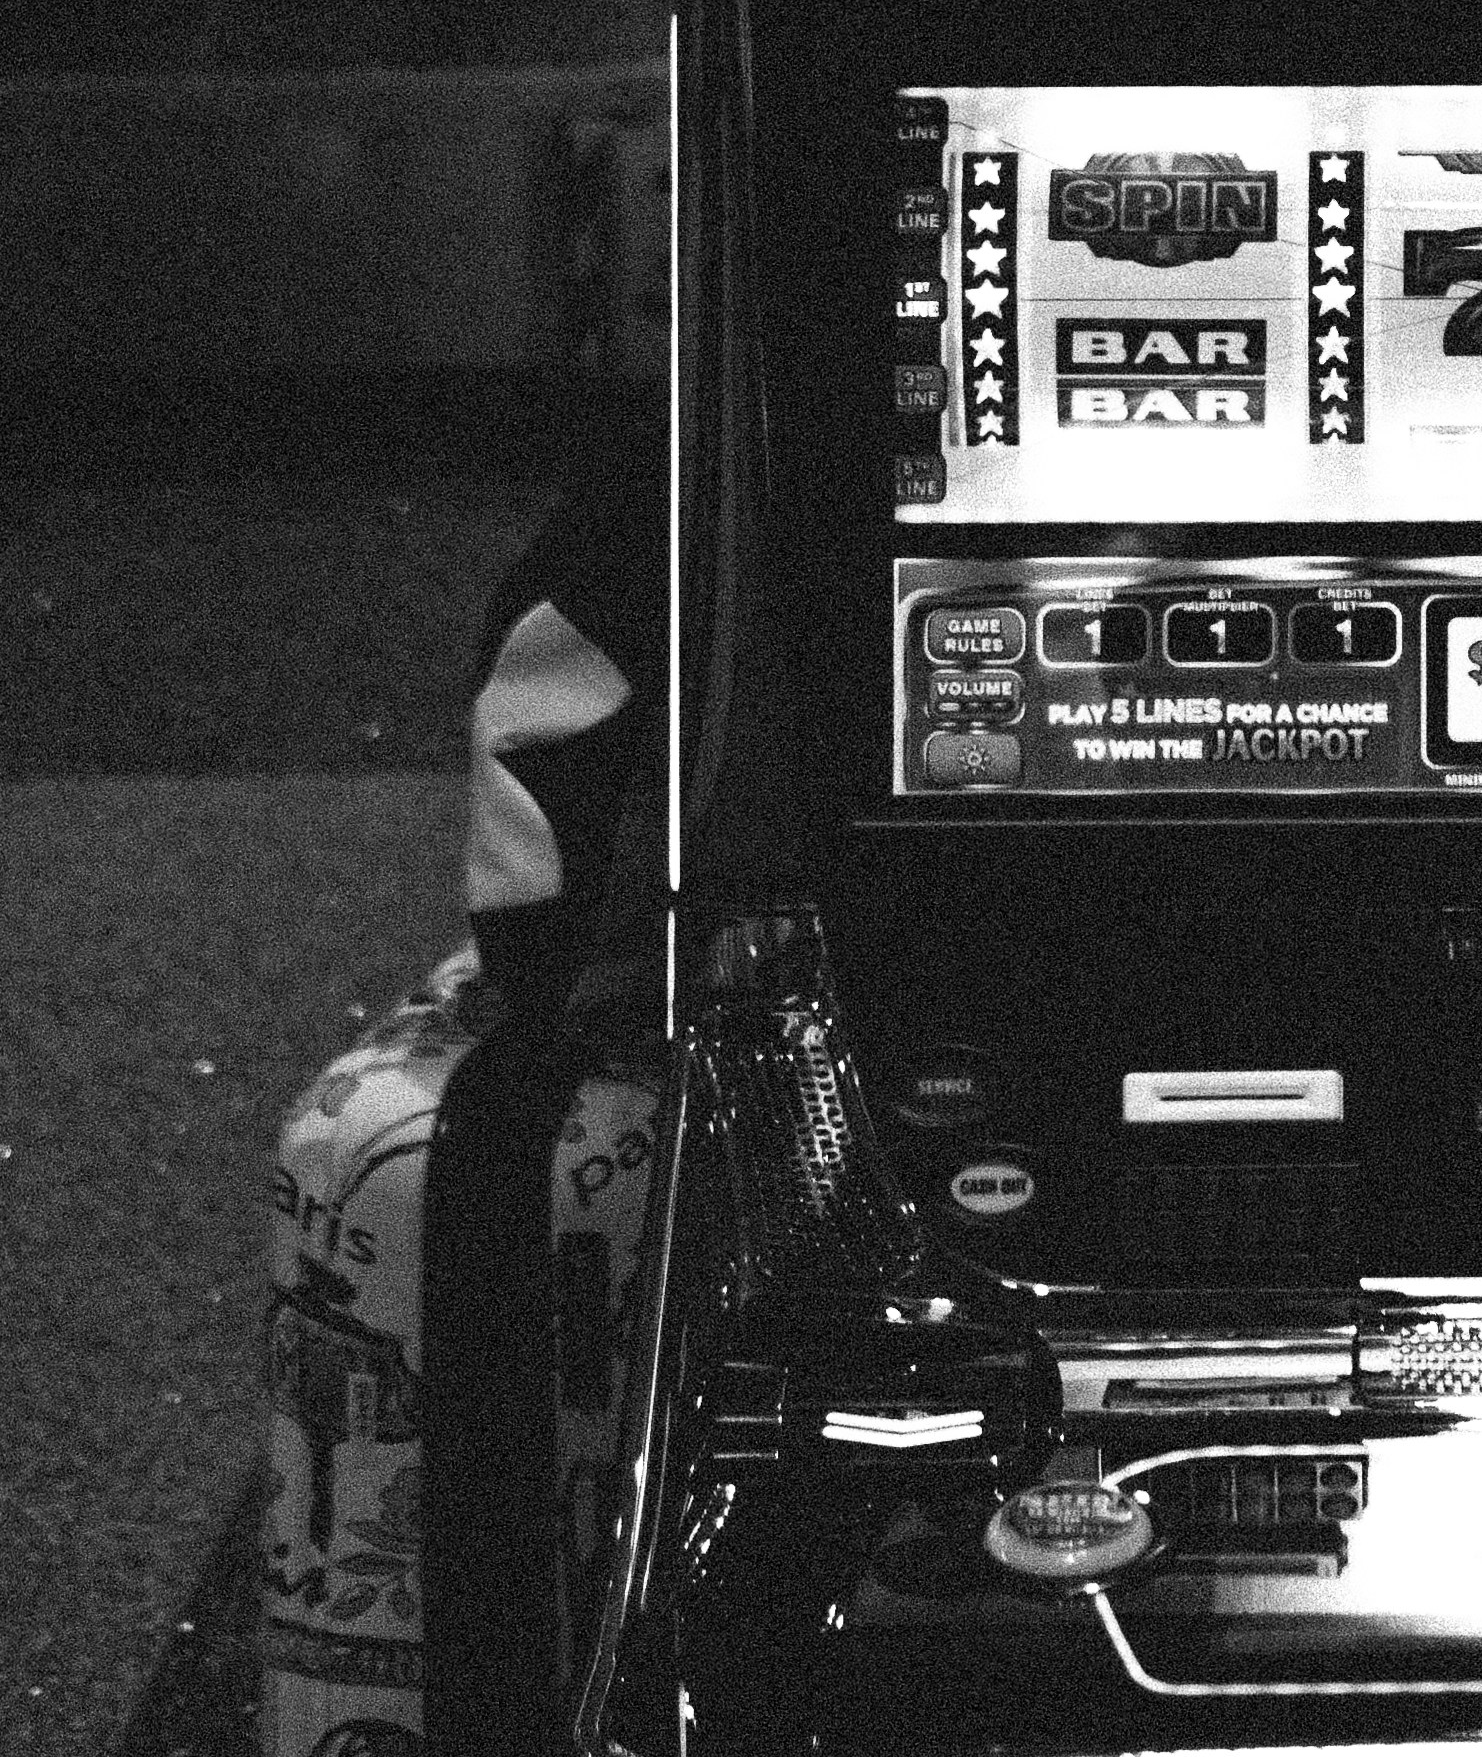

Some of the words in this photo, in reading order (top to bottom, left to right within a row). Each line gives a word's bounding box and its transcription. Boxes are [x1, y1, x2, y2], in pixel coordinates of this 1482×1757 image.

[897, 126, 940, 141] LINE
[1058, 178, 1271, 232] SPIN
[897, 214, 940, 229] LINE
[896, 301, 940, 318] LINE
[1071, 331, 1250, 364] BAR
[896, 392, 938, 407] LINE
[1070, 389, 1251, 422] BAR
[896, 480, 937, 496] LINE
[1318, 589, 1372, 600] CREDITS
[945, 620, 1002, 635] GAME
[1085, 618, 1102, 654] 1
[1209, 618, 1227, 654] 1
[1336, 618, 1353, 654] 1
[945, 639, 1004, 653] RULES
[937, 683, 1012, 697] VOLUME
[1049, 704, 1107, 724] PLAY
[1111, 698, 1129, 723] 5
[1137, 698, 1223, 724] LINES
[1227, 704, 1271, 724] FOR
[1275, 704, 1293, 723] A
[1298, 704, 1388, 724] CHANCE
[1074, 740, 1106, 760] TO
[1110, 740, 1162, 760] WIN
[1166, 740, 1203, 759] THE
[1213, 729, 1370, 762] JACKPOT
